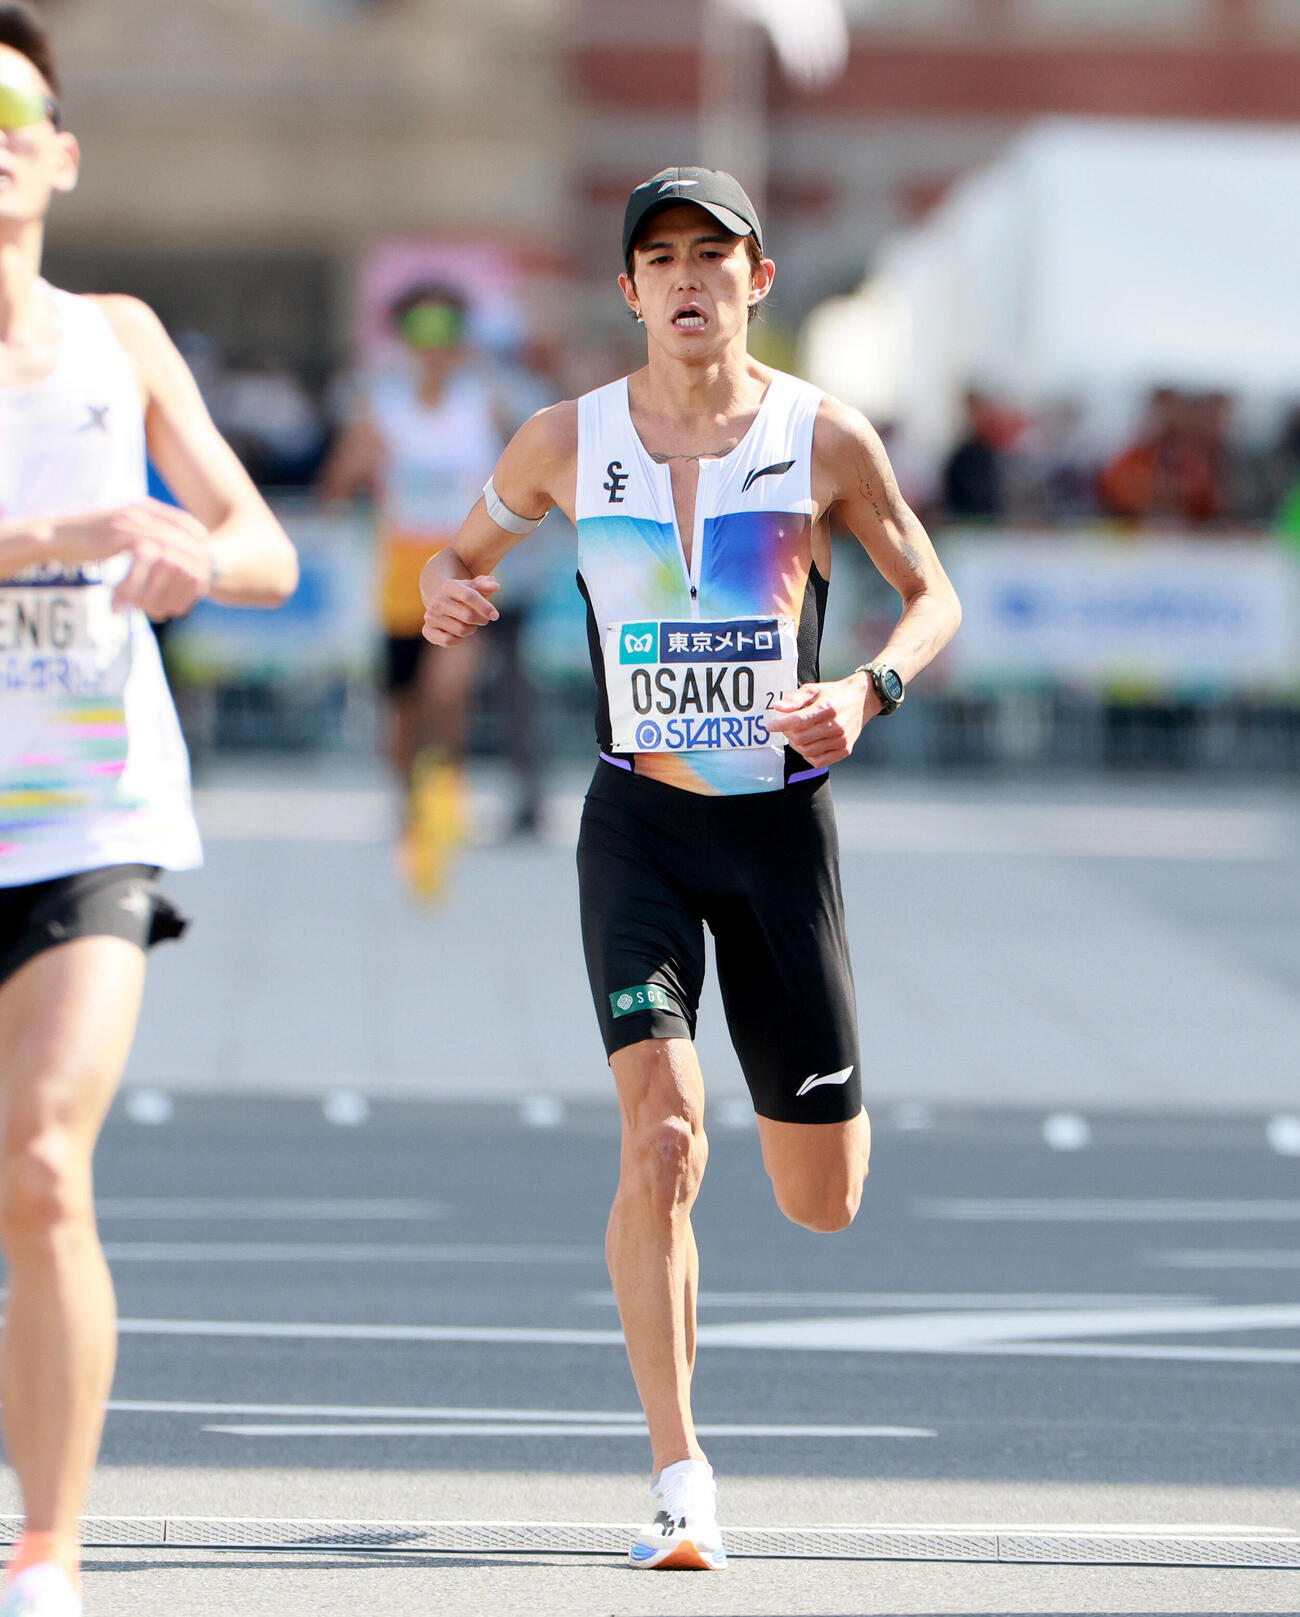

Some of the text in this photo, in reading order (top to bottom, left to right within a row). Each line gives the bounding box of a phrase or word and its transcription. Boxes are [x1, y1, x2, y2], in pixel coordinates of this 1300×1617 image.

[668, 631, 773, 653] 東京メトロ
[631, 666, 755, 715] OSAKO
[765, 691, 784, 710] 2
[665, 715, 770, 749] STARTS
